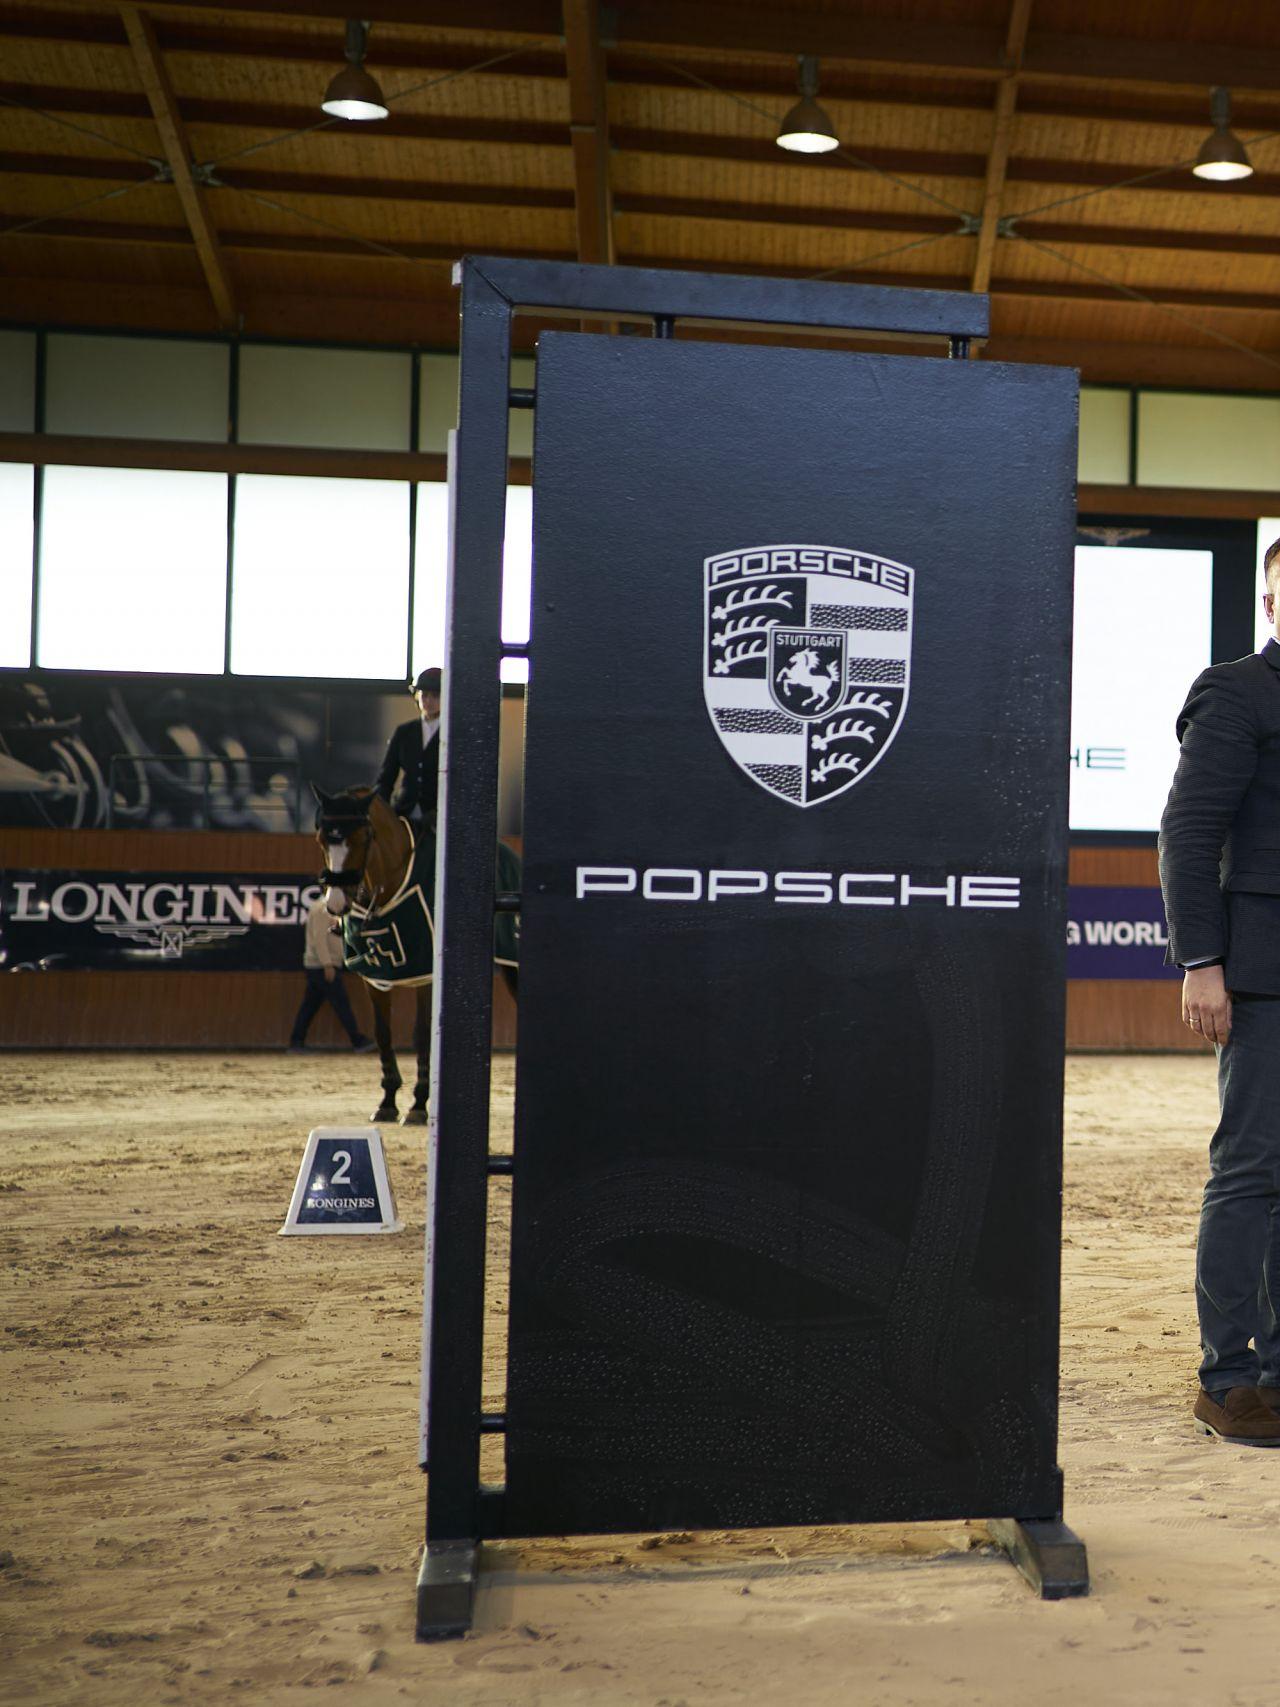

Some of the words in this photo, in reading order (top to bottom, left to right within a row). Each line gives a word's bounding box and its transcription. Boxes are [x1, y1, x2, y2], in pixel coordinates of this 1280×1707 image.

[711, 550, 907, 593] PORSCHE
[776, 634, 842, 648] STUTTGART
[330, 1150, 352, 1185] 2
[306, 1198, 375, 1209] LONGINES
